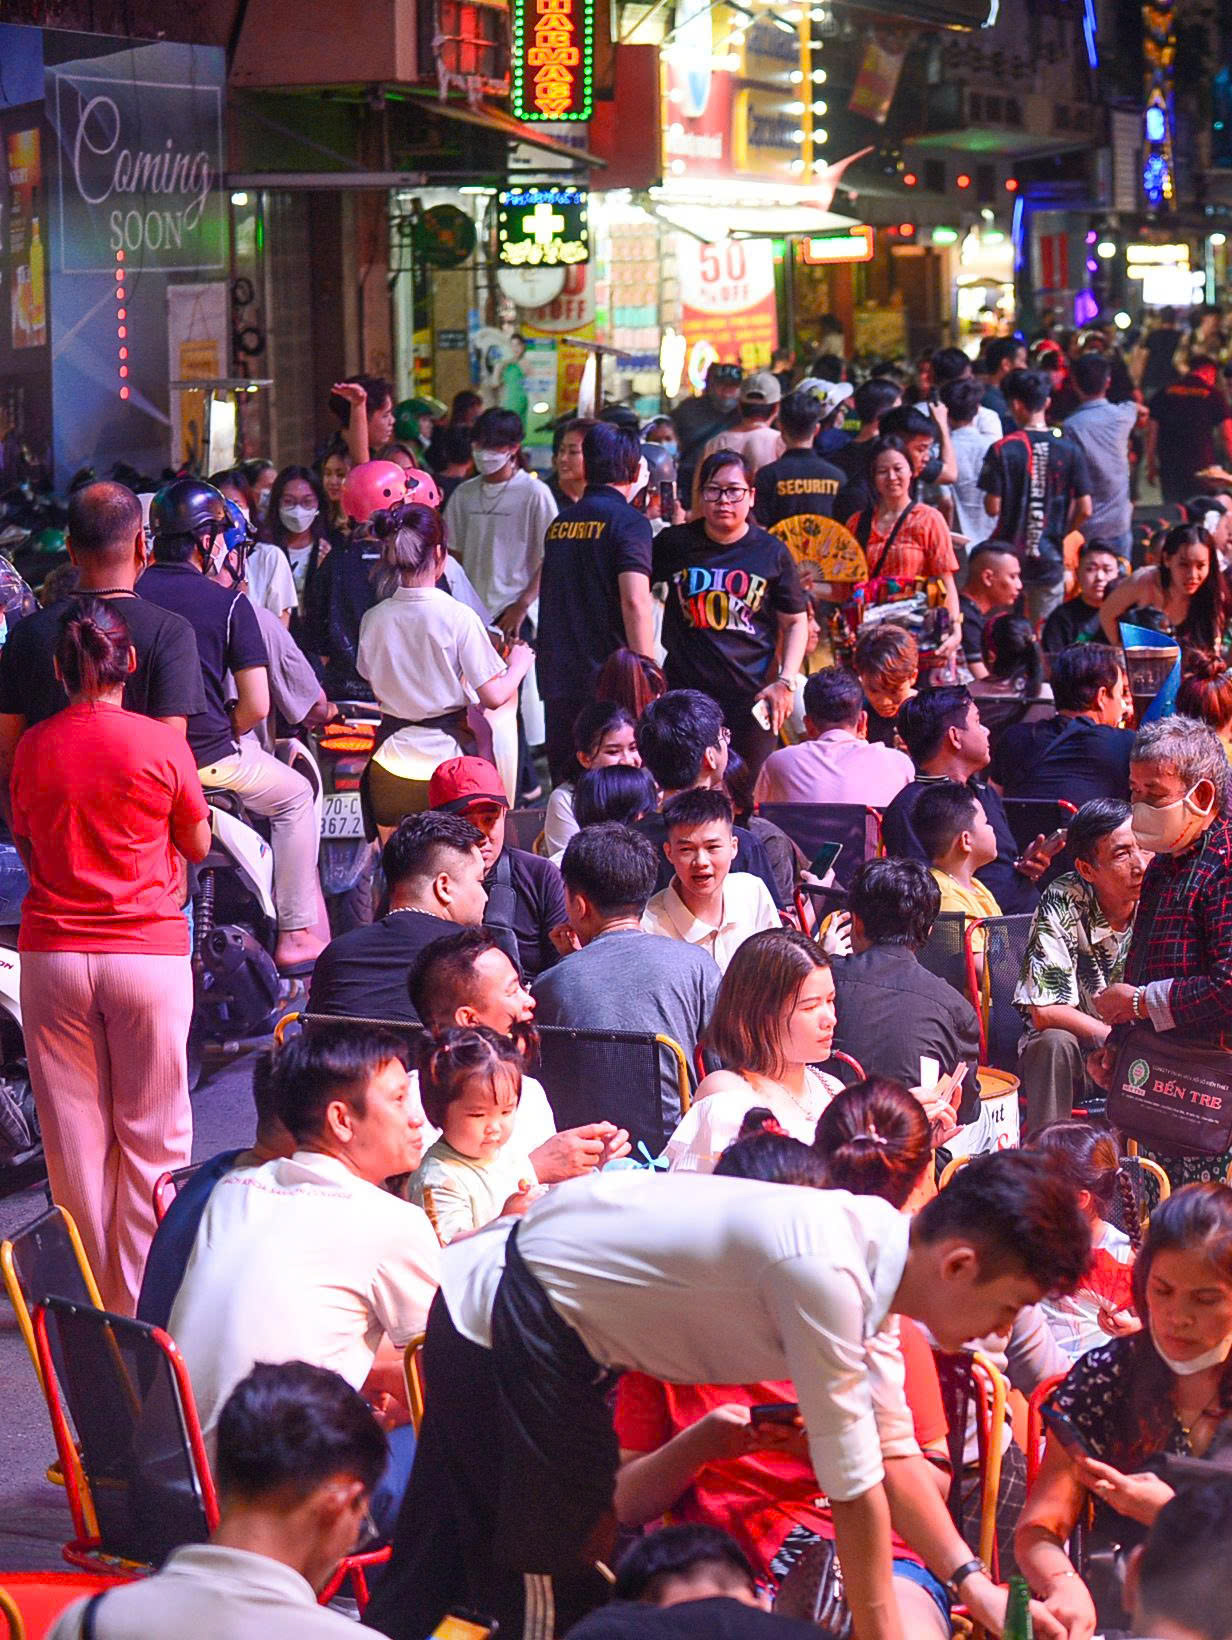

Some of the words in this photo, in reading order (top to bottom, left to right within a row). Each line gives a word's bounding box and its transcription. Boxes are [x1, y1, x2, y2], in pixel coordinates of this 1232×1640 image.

[74, 96, 212, 230] Coming
[110, 210, 183, 250] SOON
[699, 240, 747, 283] 50
[776, 478, 840, 496] SECURITY
[547, 521, 607, 540] ECURITY
[1152, 1080, 1187, 1100] BẾN
